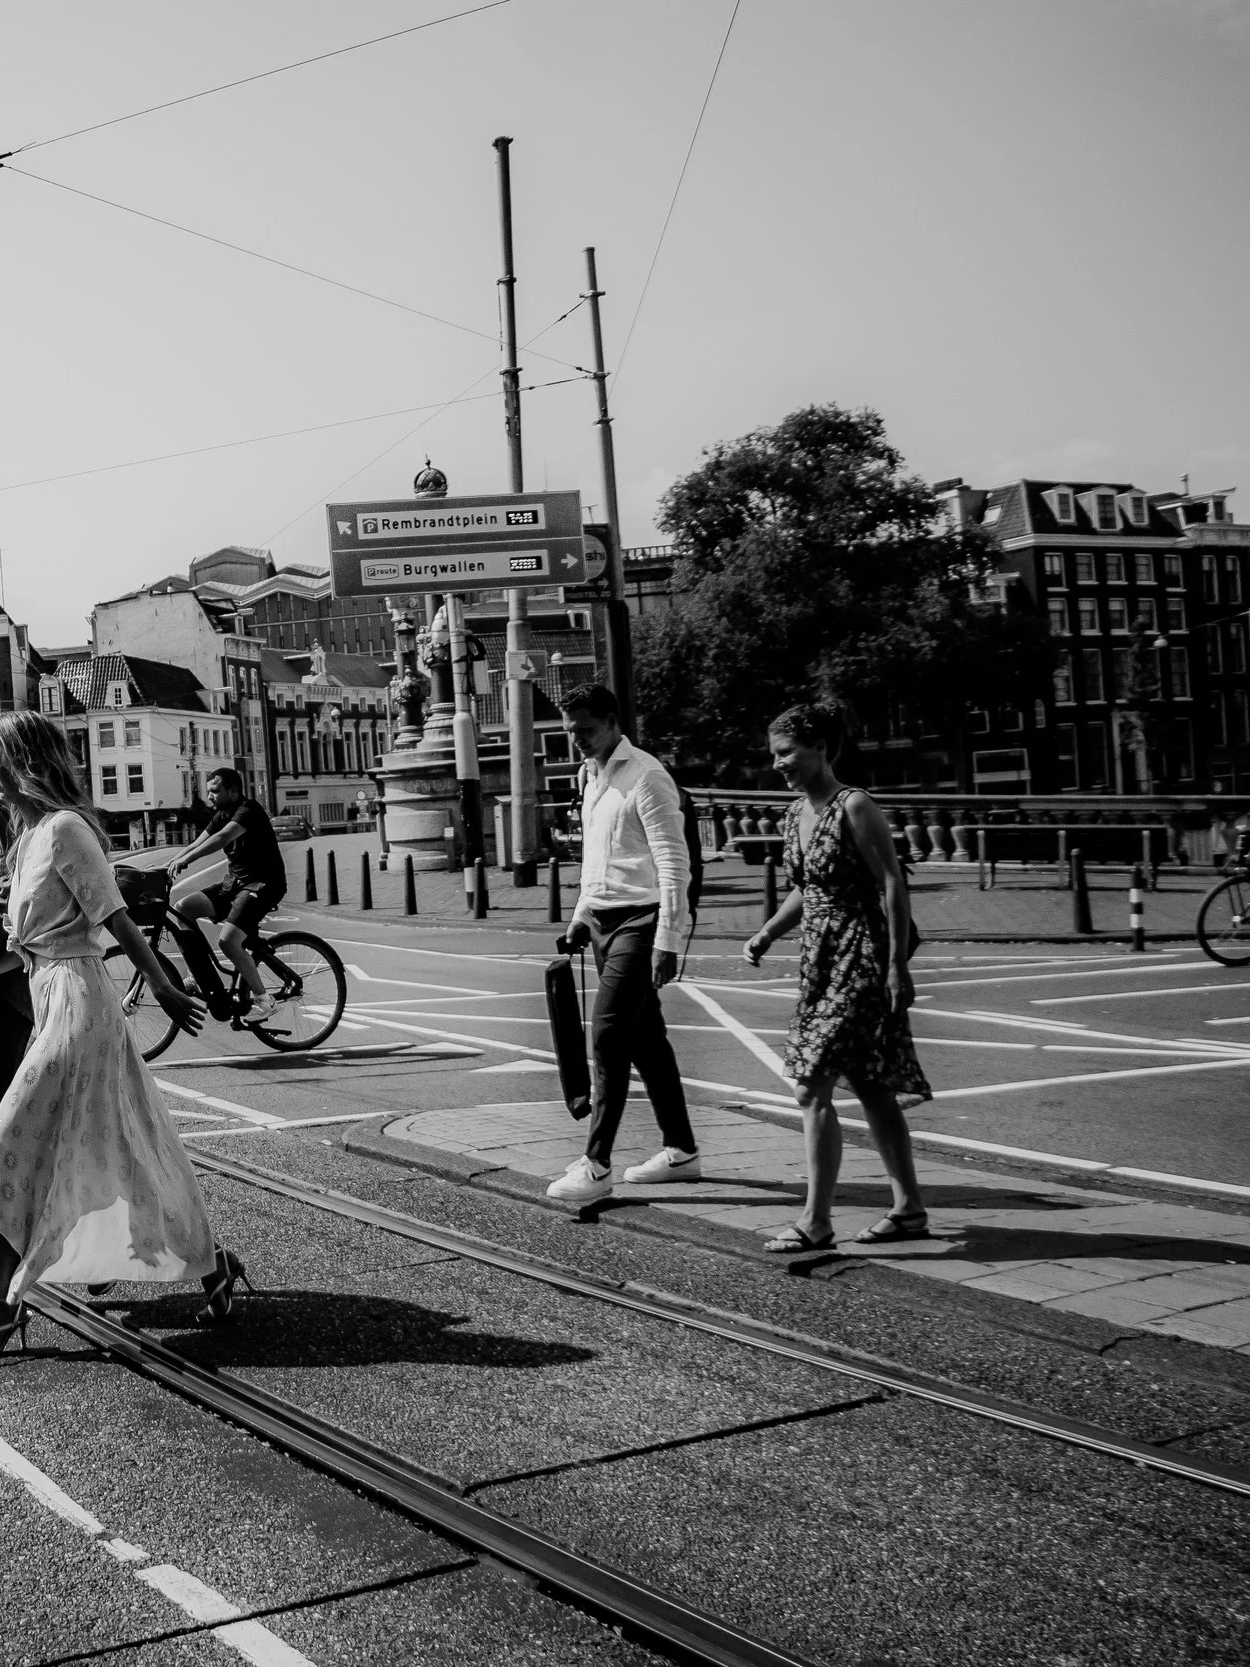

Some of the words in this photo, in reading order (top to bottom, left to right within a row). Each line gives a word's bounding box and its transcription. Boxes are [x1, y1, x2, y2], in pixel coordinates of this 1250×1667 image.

[382, 513, 498, 531] Rembrandtplein
[376, 567, 397, 575] route
[403, 560, 485, 578] Burgwallen
